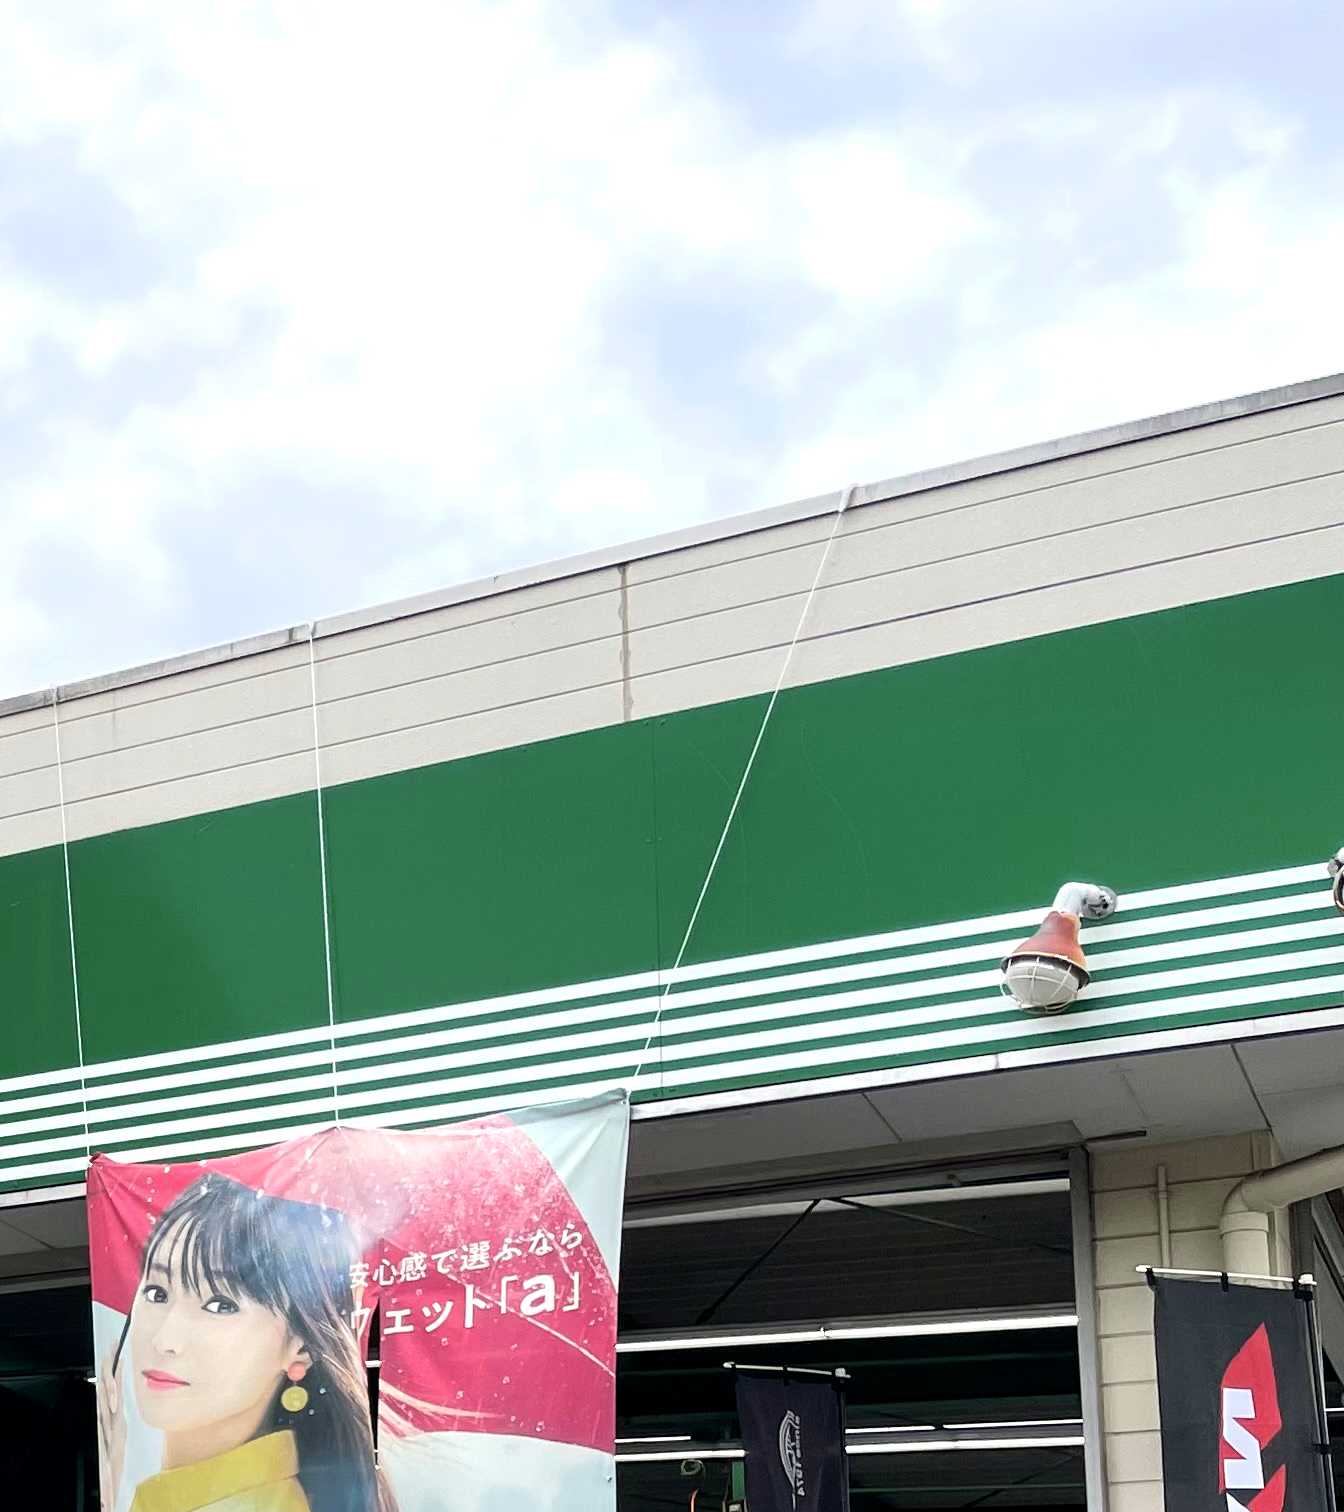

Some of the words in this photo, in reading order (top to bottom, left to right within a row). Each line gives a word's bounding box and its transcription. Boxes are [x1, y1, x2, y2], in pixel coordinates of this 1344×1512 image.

[348, 1222, 584, 1290] 安心感で選ぶなら
